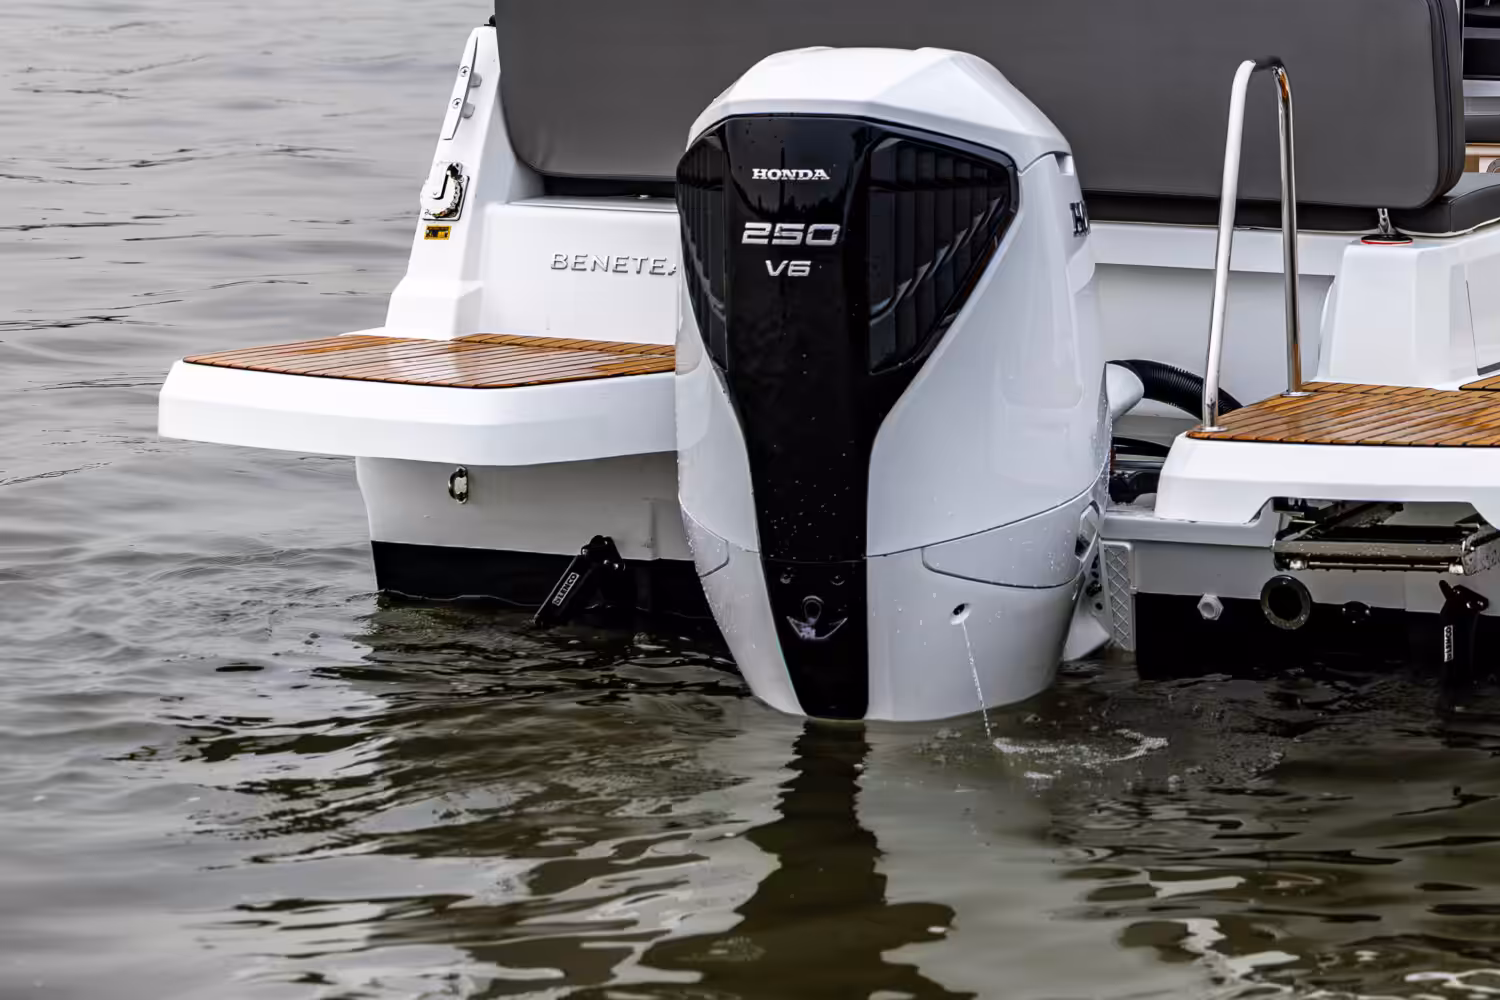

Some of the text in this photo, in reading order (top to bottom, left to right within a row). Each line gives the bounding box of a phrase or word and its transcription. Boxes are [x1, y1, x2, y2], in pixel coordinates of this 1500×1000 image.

[752, 168, 830, 180] HONDA
[741, 222, 841, 246] 250
[765, 260, 812, 277] V6
